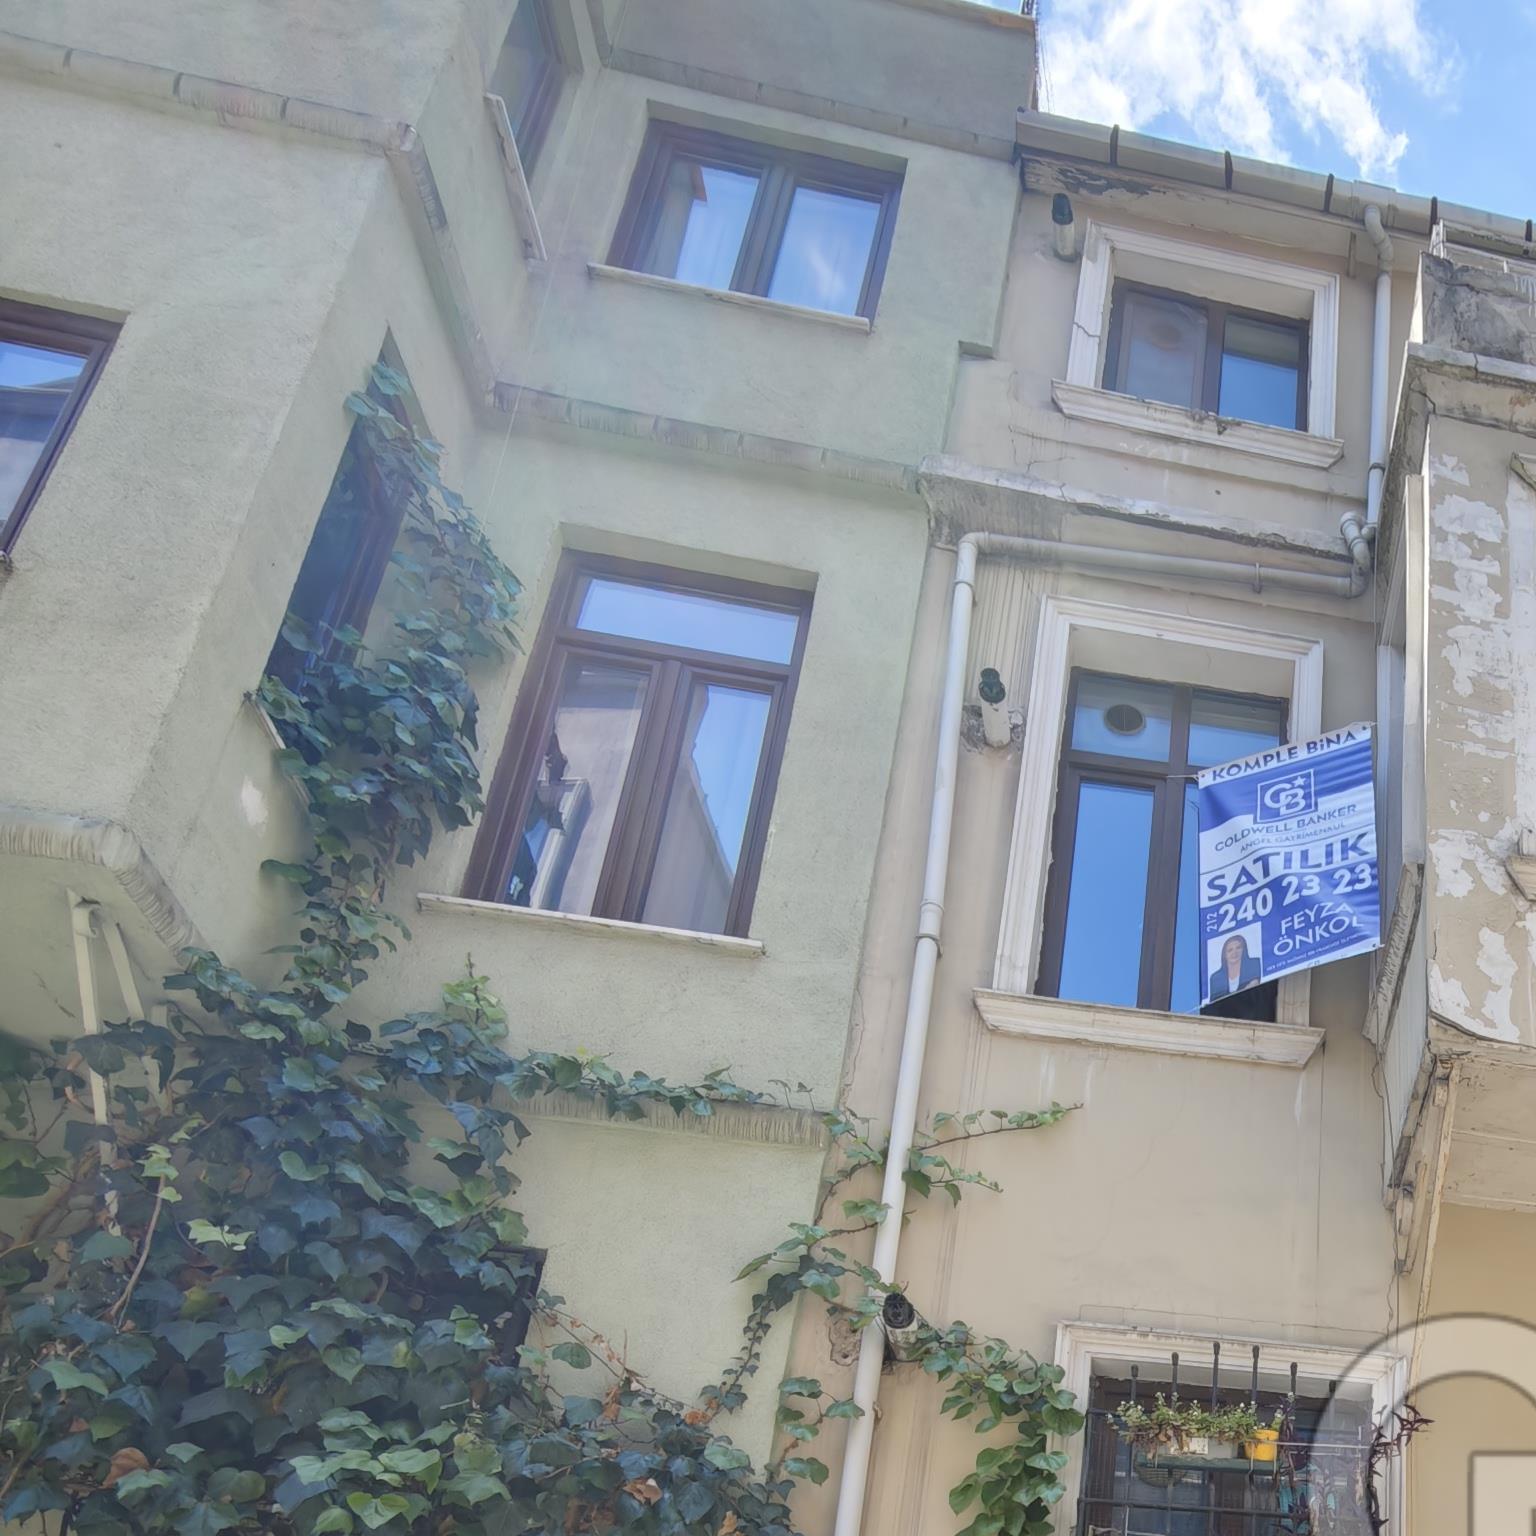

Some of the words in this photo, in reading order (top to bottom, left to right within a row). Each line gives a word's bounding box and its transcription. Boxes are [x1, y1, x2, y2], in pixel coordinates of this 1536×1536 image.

[1212, 745, 1299, 782] KOMPLE
[1214, 822, 1292, 852] COLDWELL
[1297, 804, 1357, 829] BANKER
[1207, 832, 1371, 902] SATILIK
[1206, 911, 1218, 932] 212
[1218, 888, 1273, 933] 240
[1281, 875, 1320, 906] 23
[1333, 863, 1372, 895] 23
[1281, 901, 1354, 935] FEYZA
[1273, 916, 1364, 956] ÖNKOL
